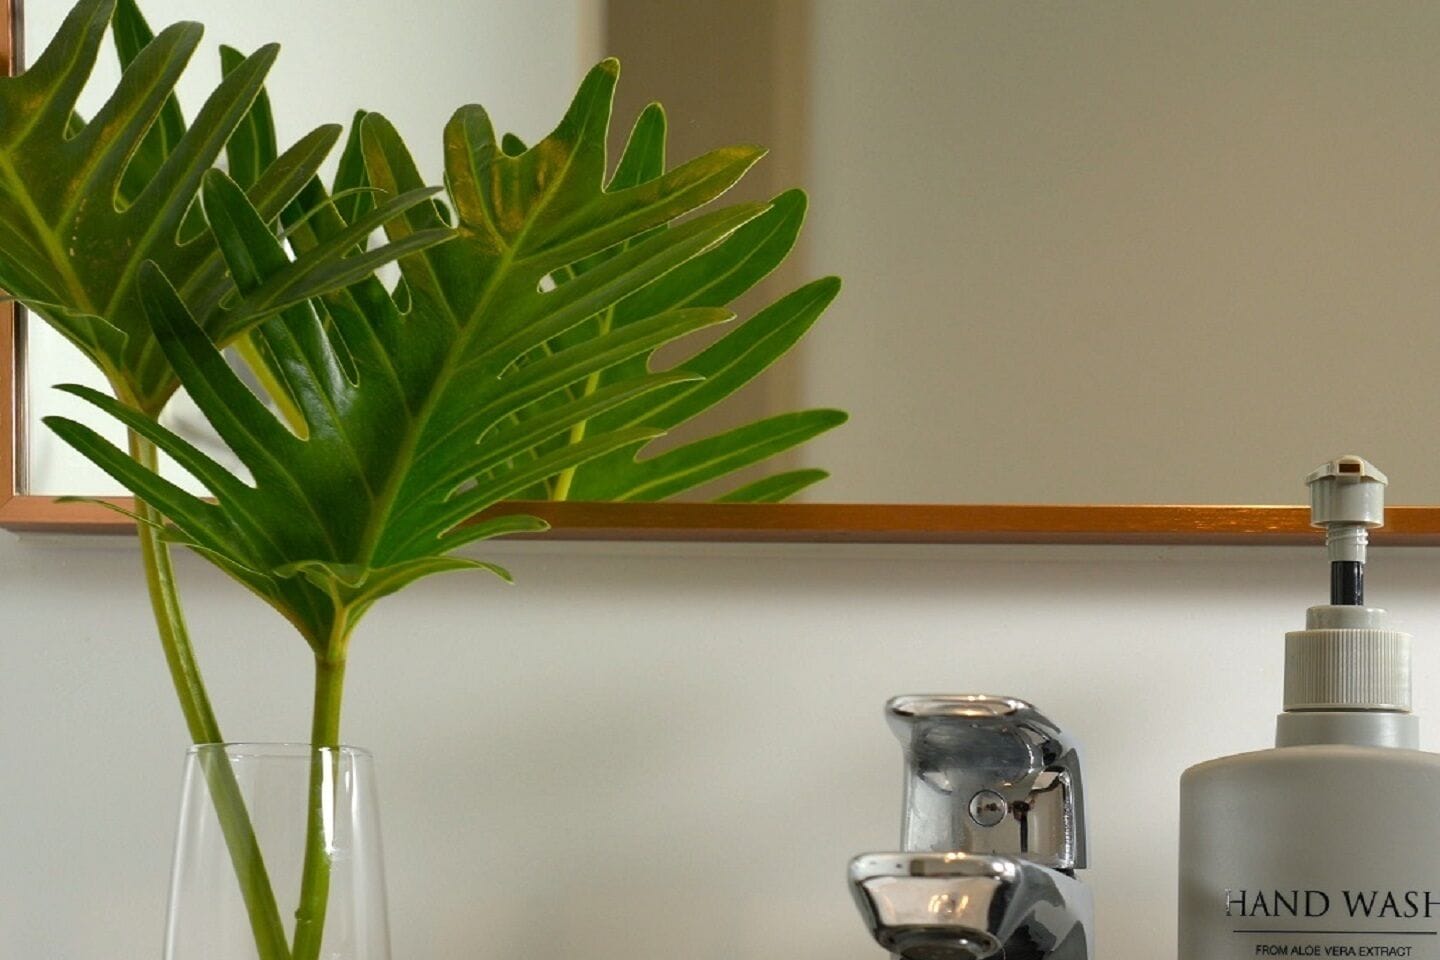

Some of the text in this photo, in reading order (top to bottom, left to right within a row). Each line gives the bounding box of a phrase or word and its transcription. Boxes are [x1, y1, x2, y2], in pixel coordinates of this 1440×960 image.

[1225, 888, 1330, 918] HAND
[1255, 944, 1413, 958] FROM ALOE VERA EXTRACT
